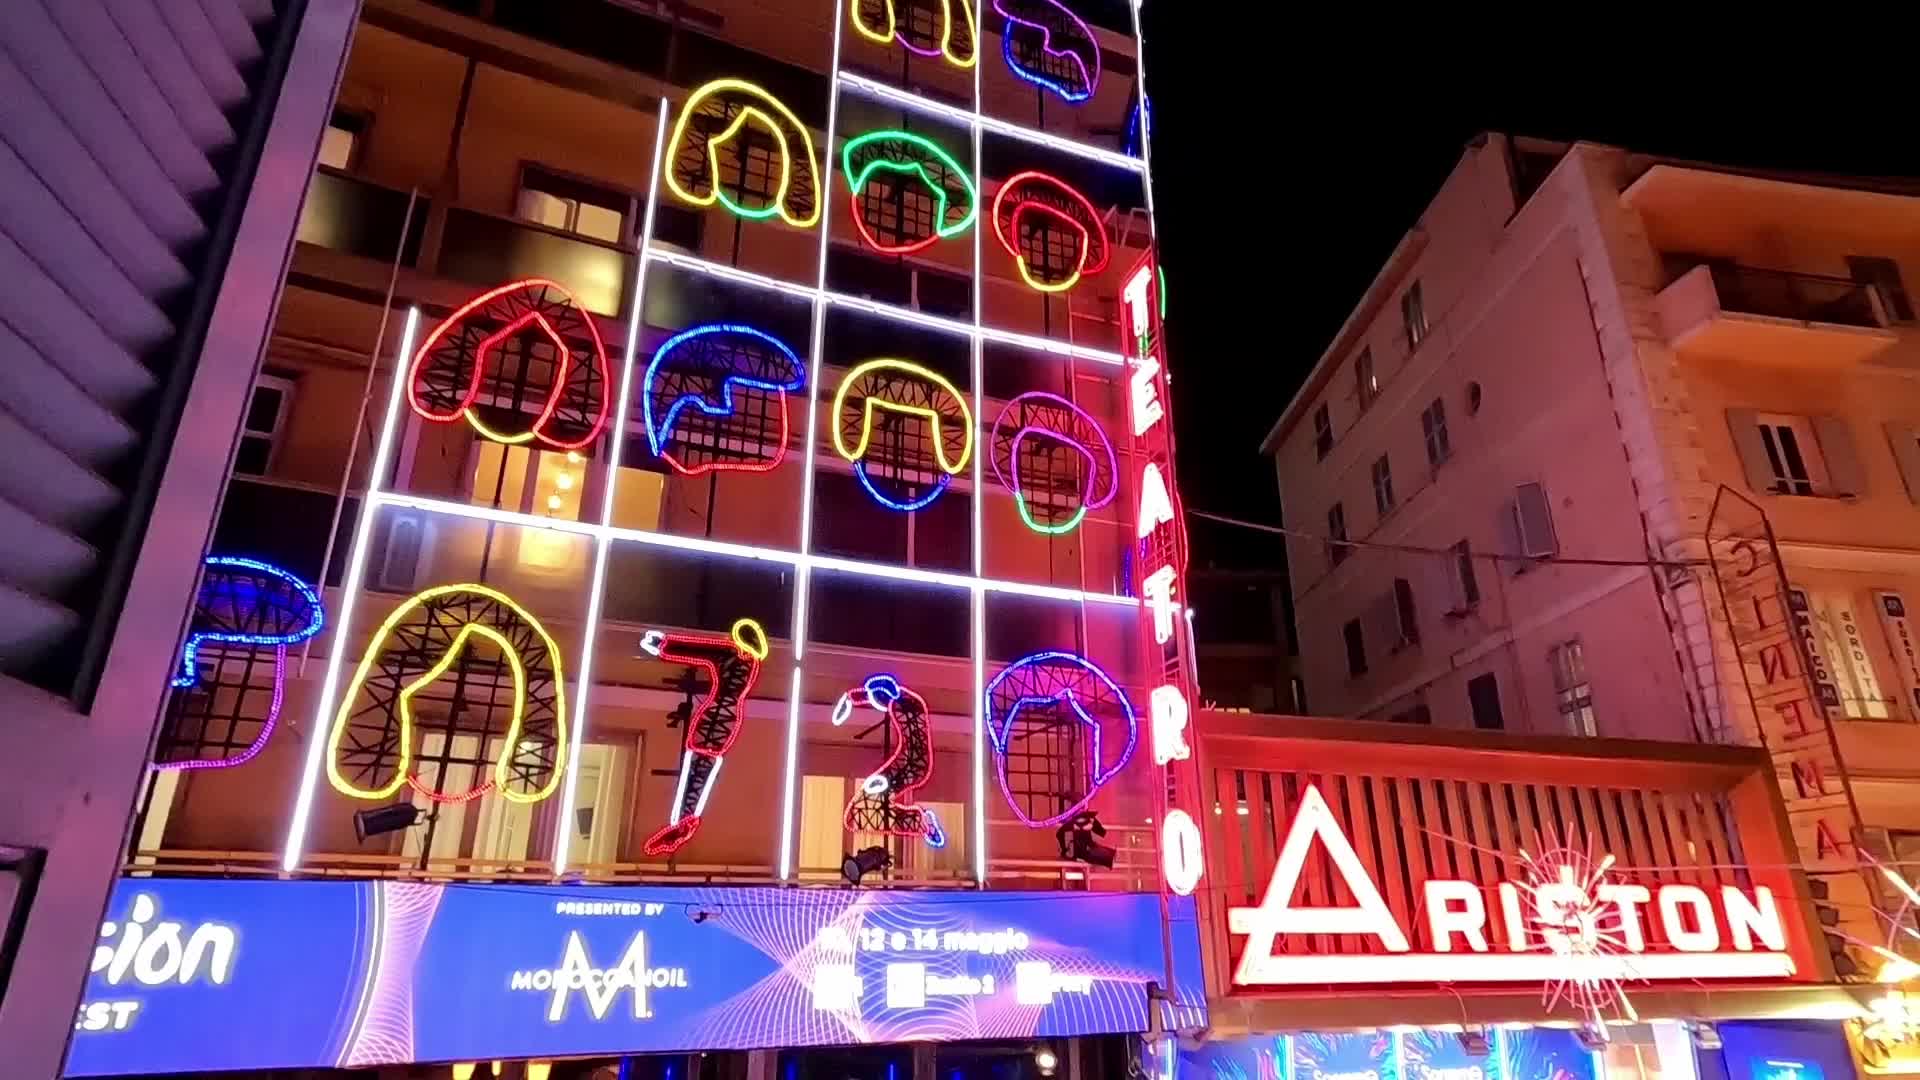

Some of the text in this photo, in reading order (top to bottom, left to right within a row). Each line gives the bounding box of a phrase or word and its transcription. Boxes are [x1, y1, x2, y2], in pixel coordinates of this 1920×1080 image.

[1123, 266, 1205, 898] TEATRO
[556, 901, 664, 916] PRESENTED BY
[911, 927, 939, 952] 14
[943, 927, 1029, 955] maggio
